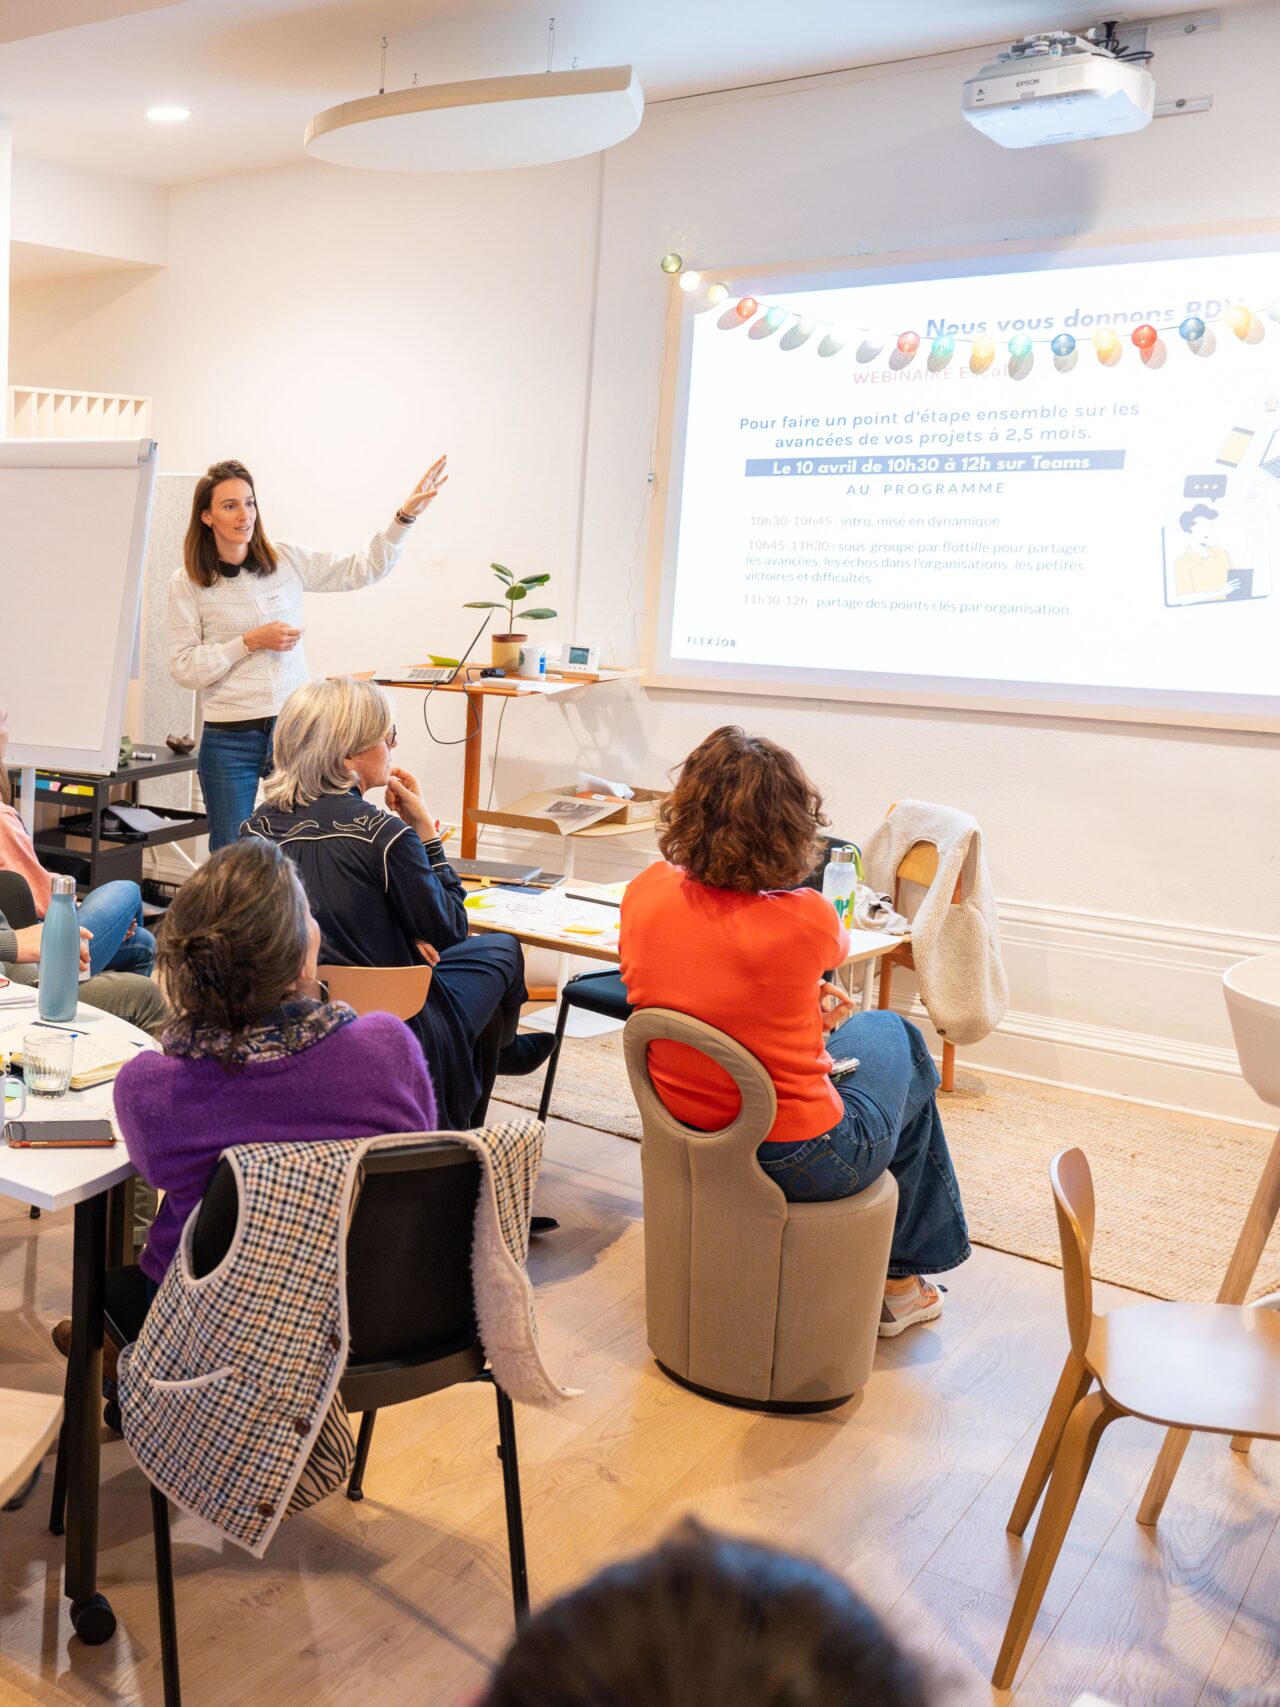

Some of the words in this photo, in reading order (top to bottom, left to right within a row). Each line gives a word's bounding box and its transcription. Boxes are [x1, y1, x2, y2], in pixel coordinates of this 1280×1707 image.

[1015, 78, 1040, 88] EPSON
[926, 318, 987, 338] Nous
[996, 316, 1055, 332] vous
[1064, 308, 1176, 328] donnons
[1185, 298, 1245, 320] RD
[853, 367, 953, 385] WEBINAIRE
[739, 417, 777, 430] Pour
[782, 415, 820, 428] faire
[825, 416, 847, 427] un
[852, 411, 898, 428] point
[904, 409, 971, 426] d'étape
[976, 405, 1068, 420] ensemble
[1074, 405, 1107, 417] sur
[1112, 402, 1140, 416] les
[775, 432, 853, 448] avancées
[858, 432, 879, 446] de
[884, 433, 913, 445] vos
[919, 430, 983, 447] projets
[988, 427, 1000, 442] à
[1005, 427, 1034, 443] 2,5
[1039, 425, 1092, 440] mois.
[772, 461, 792, 475] Le
[795, 460, 814, 474] 10
[818, 459, 857, 474] avril
[861, 458, 882, 473] de
[887, 457, 940, 473] 10h30
[944, 457, 956, 472] à
[961, 456, 992, 471] 12h
[996, 458, 1026, 471] sur
[1031, 454, 1091, 470] Teams
[846, 484, 870, 496] AU
[883, 482, 1005, 495] PROGRAMME
[750, 515, 833, 527] 10h30-10h45
[877, 515, 906, 527] mise
[909, 517, 925, 527] en
[927, 515, 1001, 529] dynamique
[748, 540, 830, 551] 10h45-11h30
[917, 543, 939, 554] par
[942, 541, 991, 553] flottille
[993, 544, 1024, 555] pour
[1027, 543, 1088, 556] partager
[746, 555, 762, 566] les
[824, 556, 840, 567] les
[842, 556, 878, 568] échos
[881, 557, 911, 569] dans
[1014, 559, 1033, 570] les
[1036, 559, 1085, 573] petites
[744, 571, 794, 582] victoires
[797, 572, 808, 582] et
[811, 571, 871, 583] difficultés
[743, 594, 808, 607] 11h30-12h
[816, 598, 864, 610] partage
[866, 597, 887, 609] des
[889, 600, 929, 612] points
[931, 600, 957, 612] clés
[959, 602, 982, 613] par
